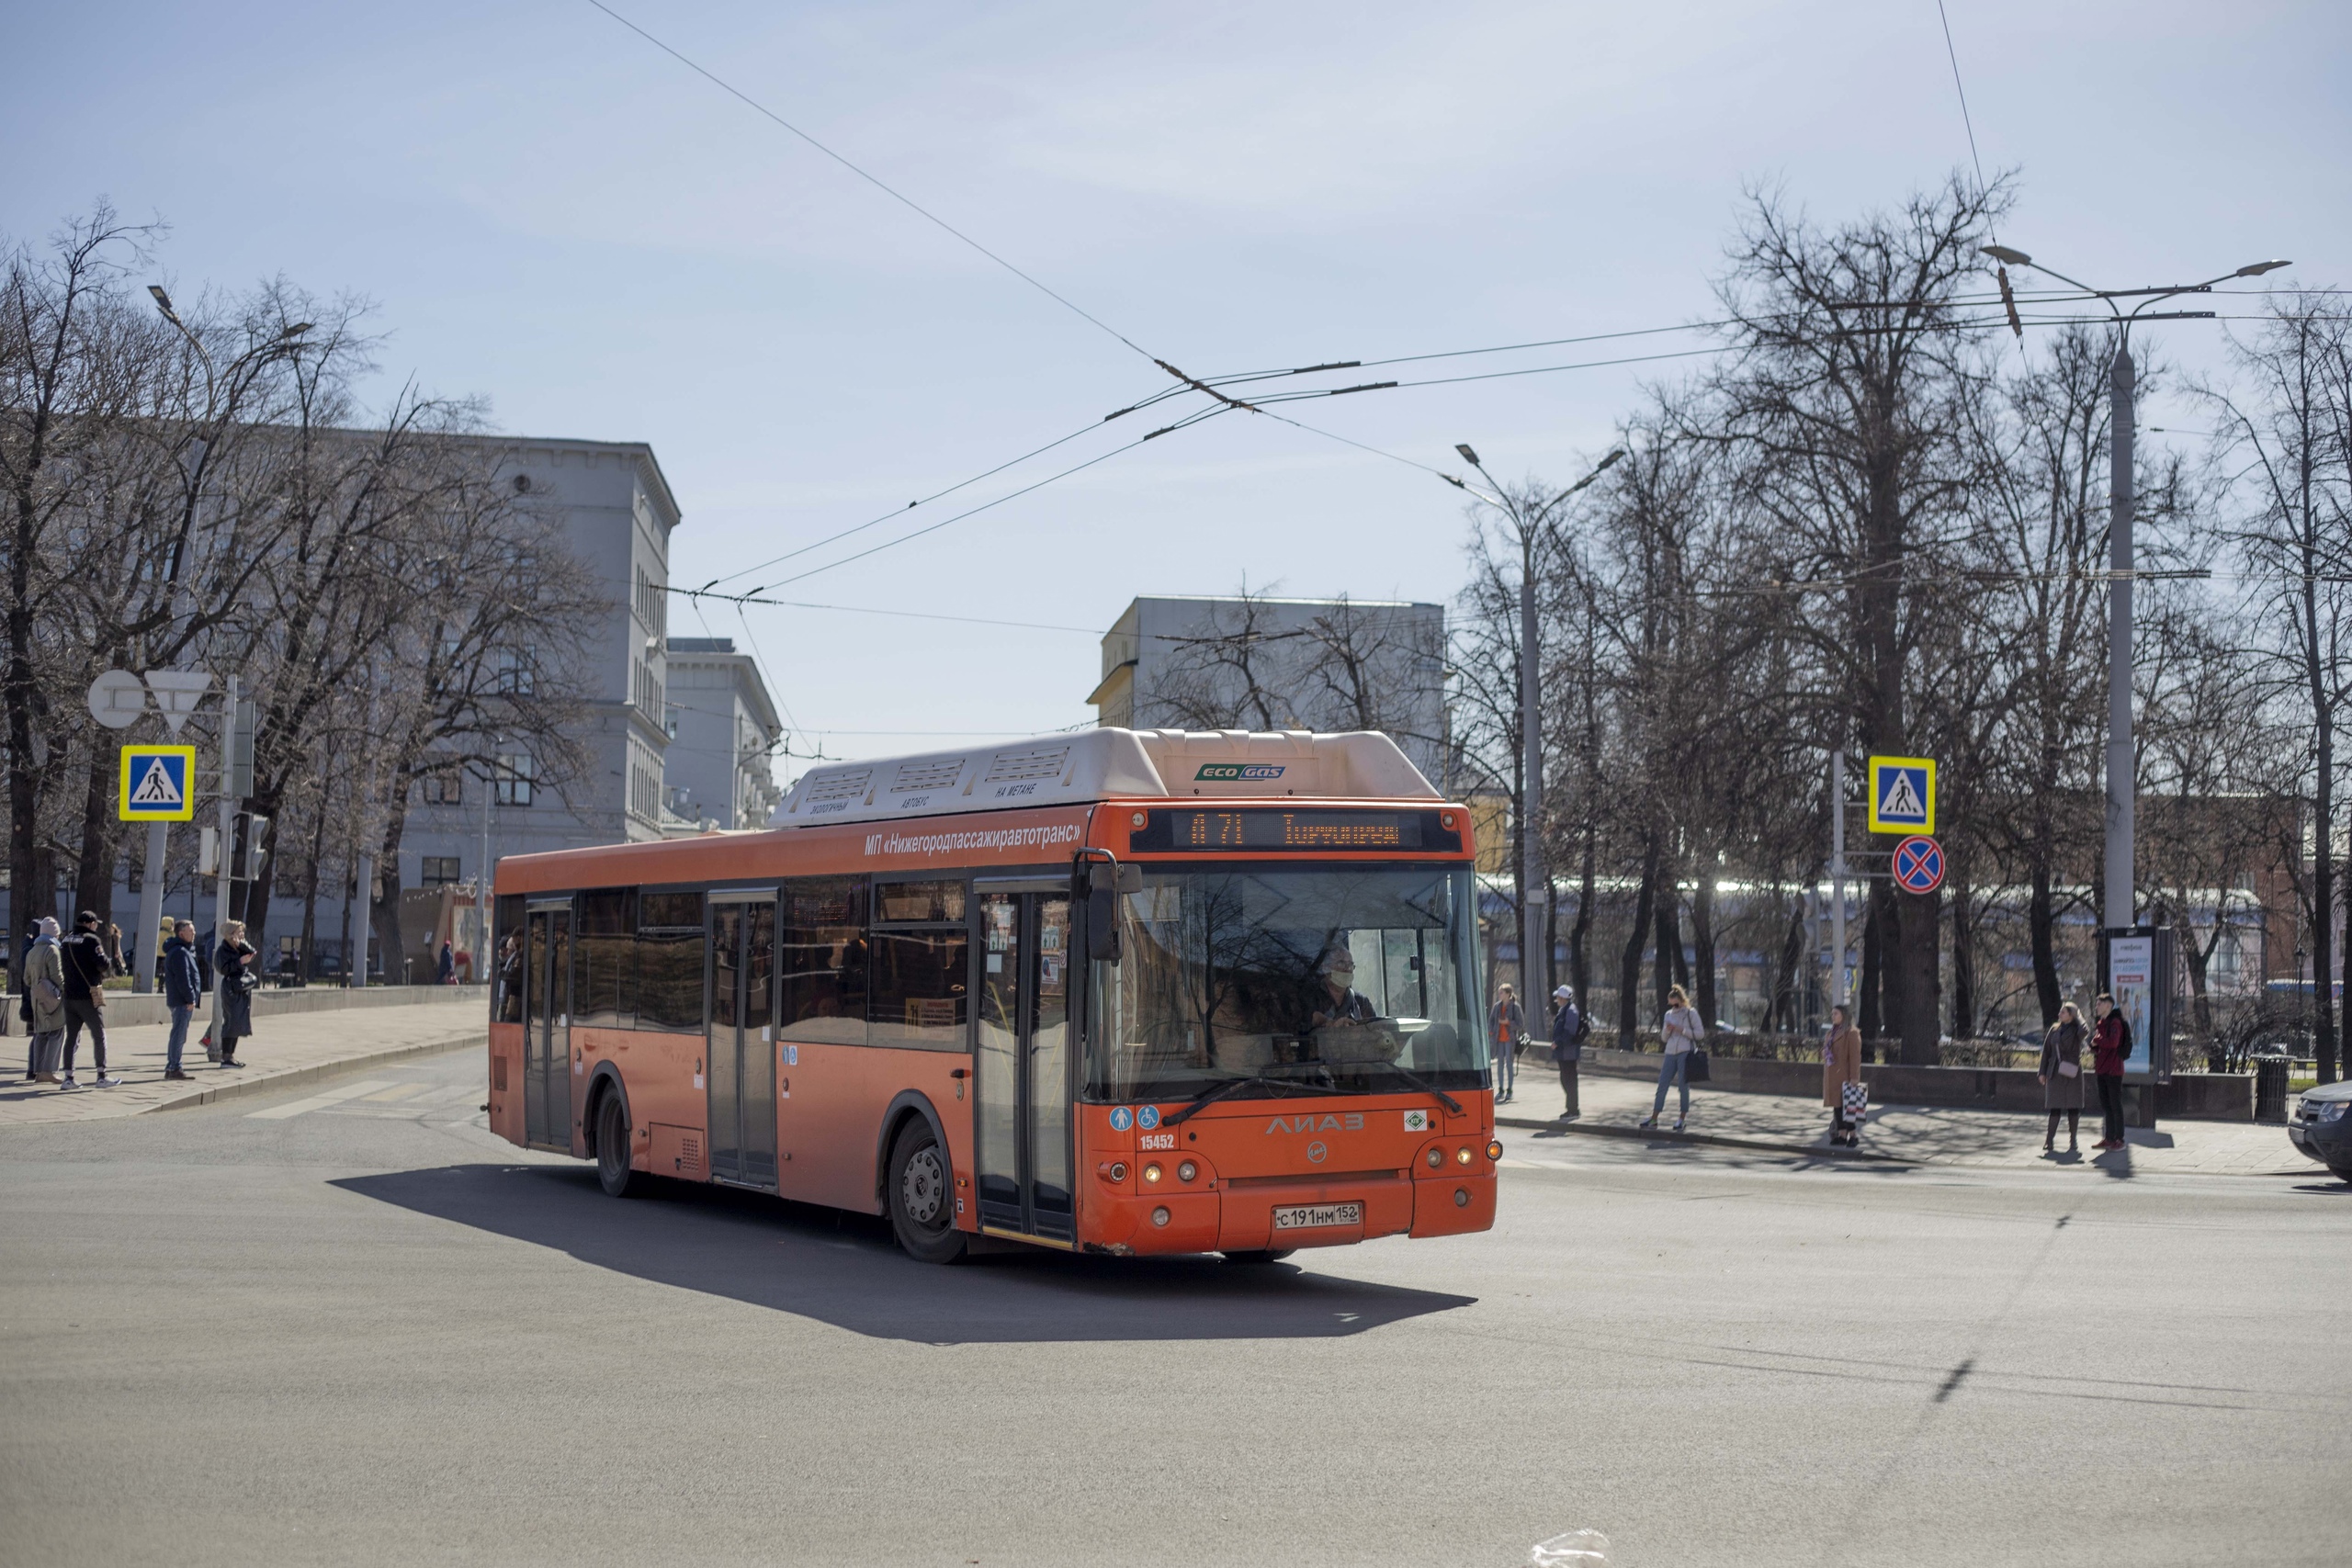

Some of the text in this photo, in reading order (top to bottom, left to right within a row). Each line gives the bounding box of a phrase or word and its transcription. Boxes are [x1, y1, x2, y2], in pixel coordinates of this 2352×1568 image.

[809, 783, 1037, 815] ЭКОЛОГИЧНЫЙ АВТОБУС НА МЕТАНЕ
[865, 824, 1080, 856] МП «Нижегородпассажиравтотранс»
[1266, 1113, 1364, 1134] ЛИАЗ
[1140, 1134, 1174, 1149] 15452
